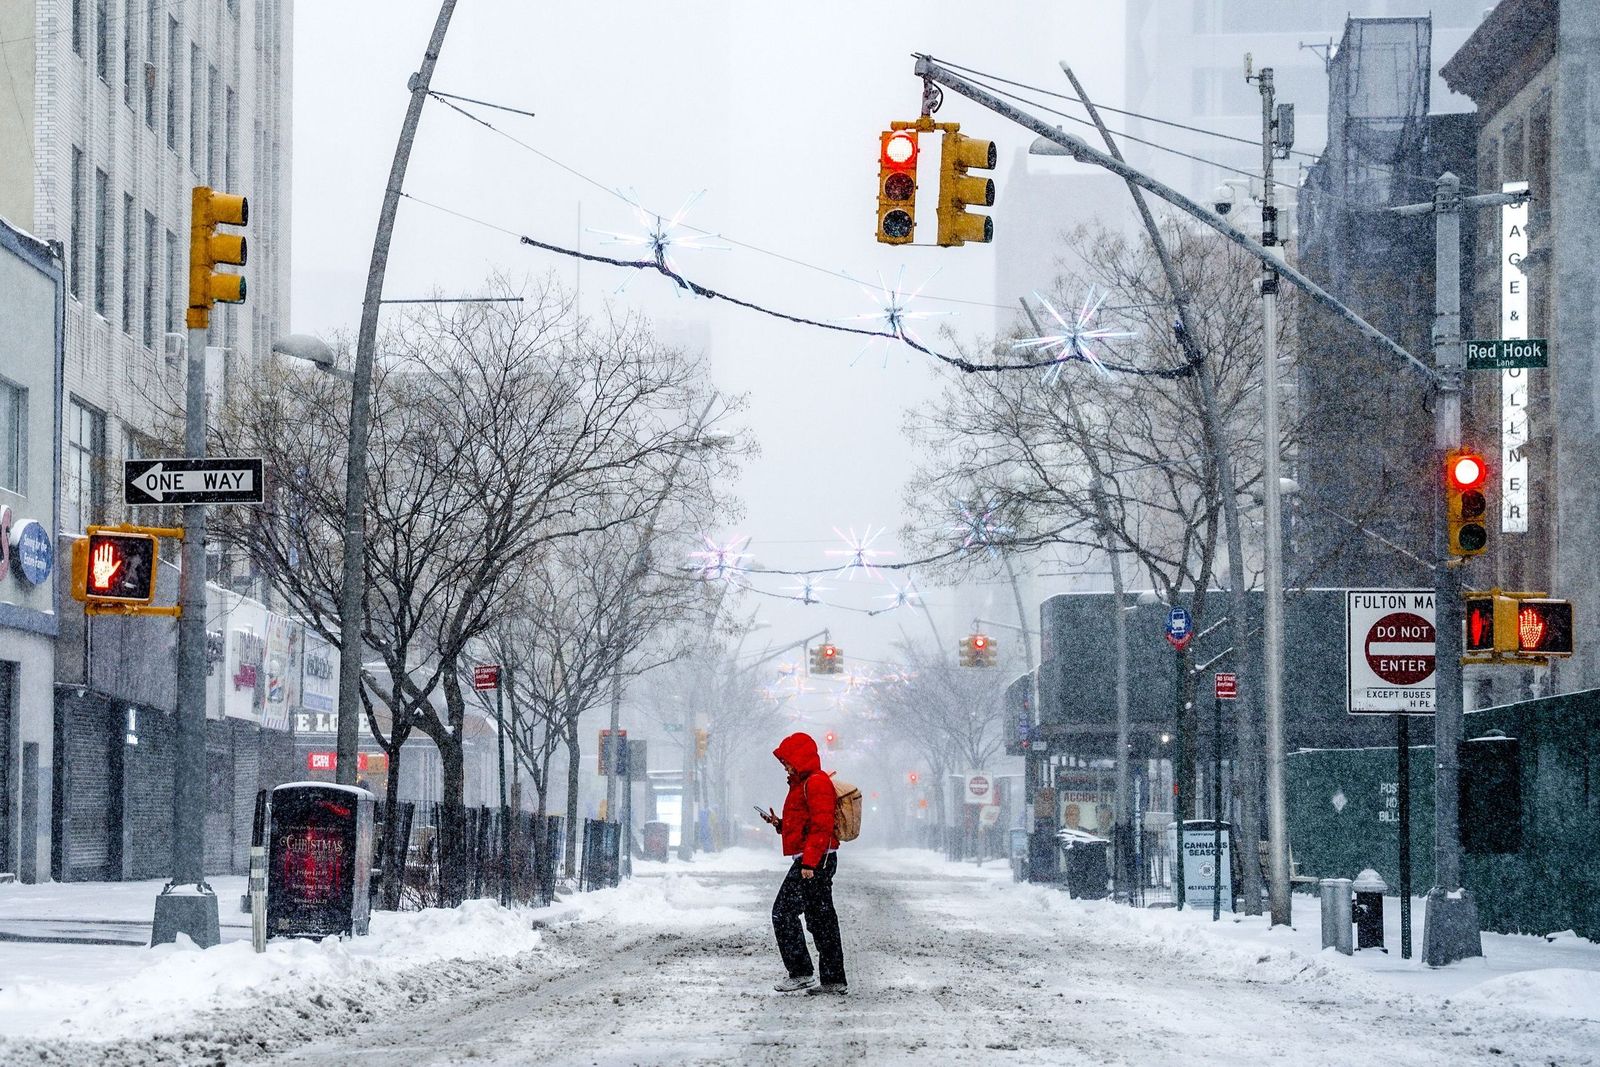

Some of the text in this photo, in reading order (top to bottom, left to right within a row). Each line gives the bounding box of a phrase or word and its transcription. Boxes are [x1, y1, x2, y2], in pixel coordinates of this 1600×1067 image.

[1510, 311, 1519, 321] &
[1469, 343, 1542, 358] Red Hook
[1508, 337, 1521, 519] OLLNER
[146, 472, 244, 490] ONE WAY
[1355, 596, 1434, 608] FULTON MA
[1377, 627, 1429, 638] DO NOT
[1380, 660, 1426, 671] ENTER
[1366, 691, 1431, 699] EXCEPT BUSES
[1380, 783, 1399, 793] POS
[279, 834, 343, 855] CHRISTMAS
